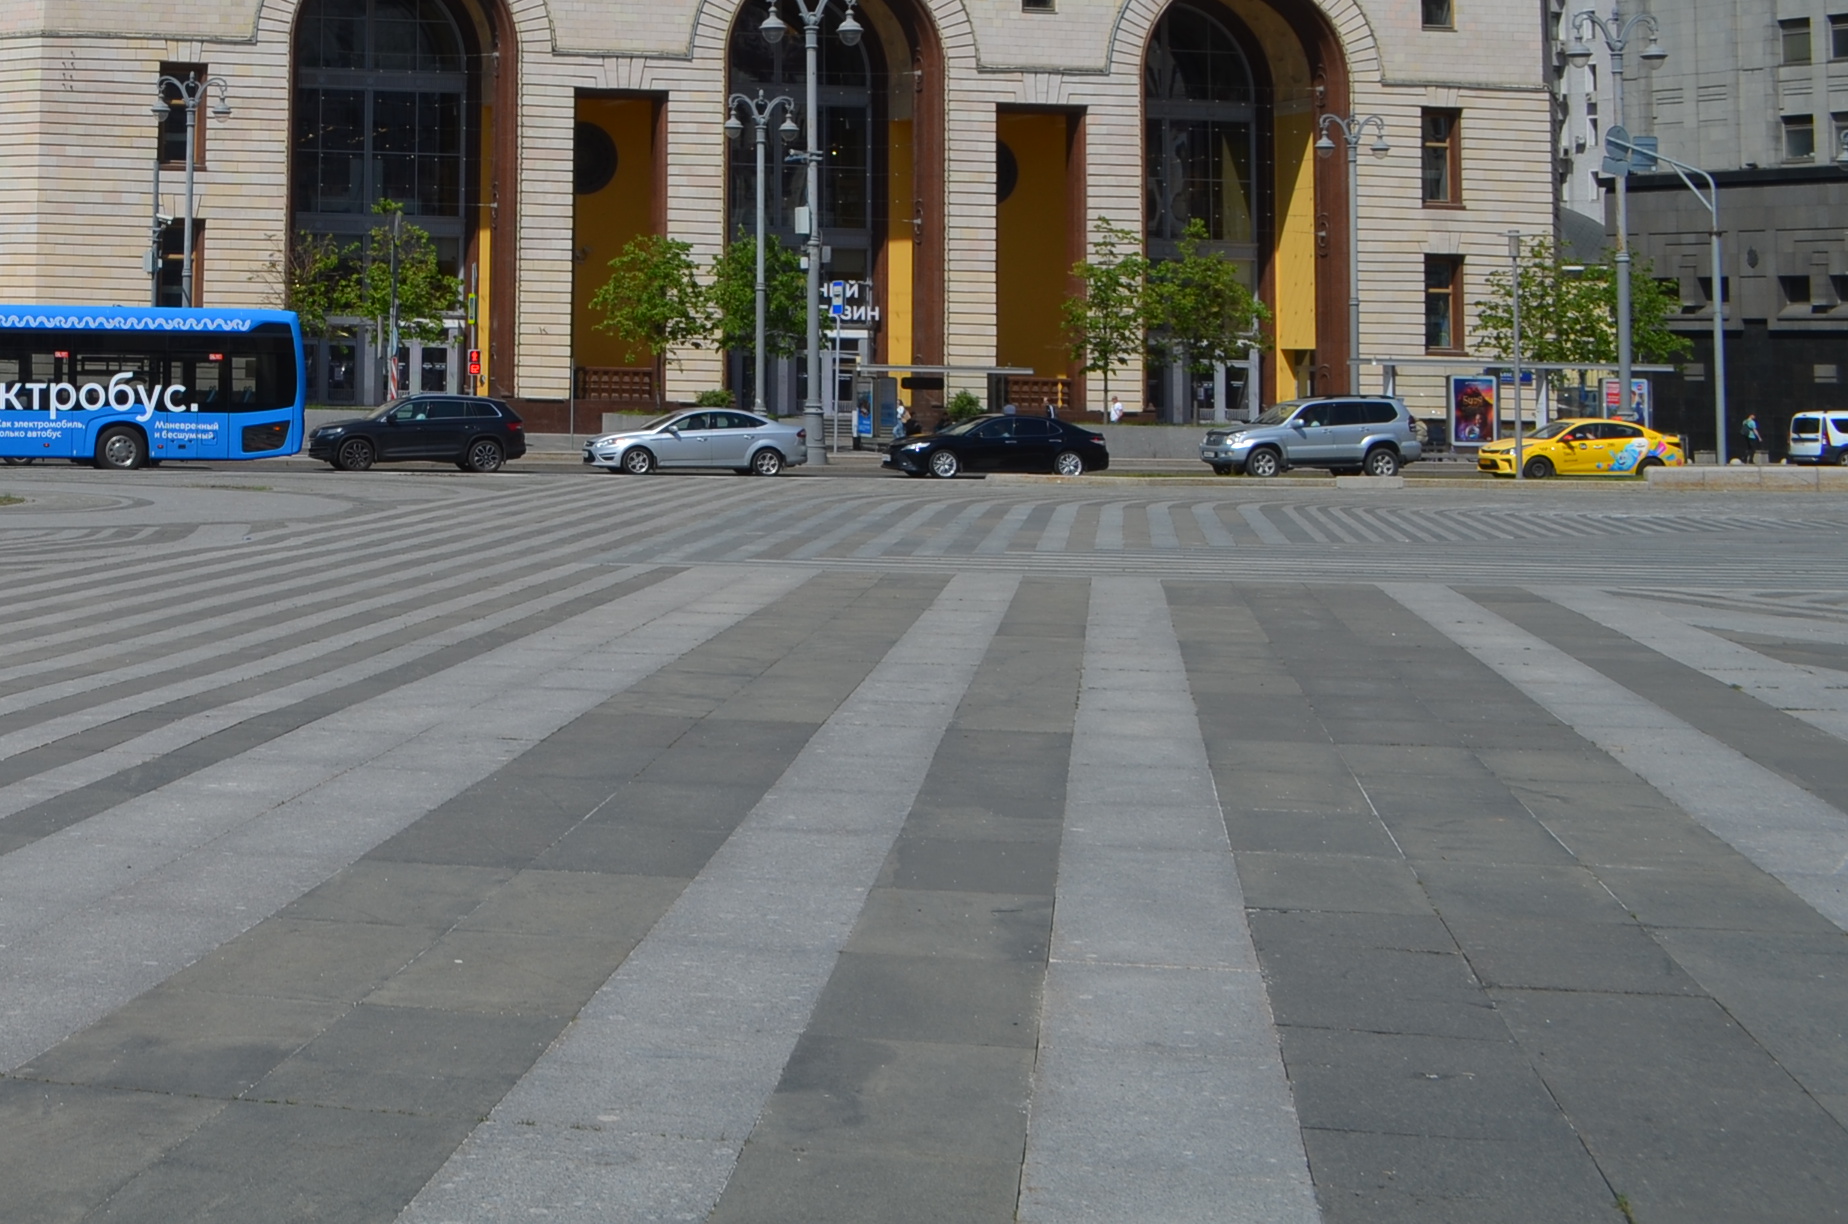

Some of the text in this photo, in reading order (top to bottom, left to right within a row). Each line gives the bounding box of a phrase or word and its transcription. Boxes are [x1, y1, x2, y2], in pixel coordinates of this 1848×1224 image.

[13, 419, 86, 429] электромобиль,
[154, 420, 219, 431] Маневренный
[26, 429, 62, 439] автобус
[161, 430, 214, 441] бесшумный
